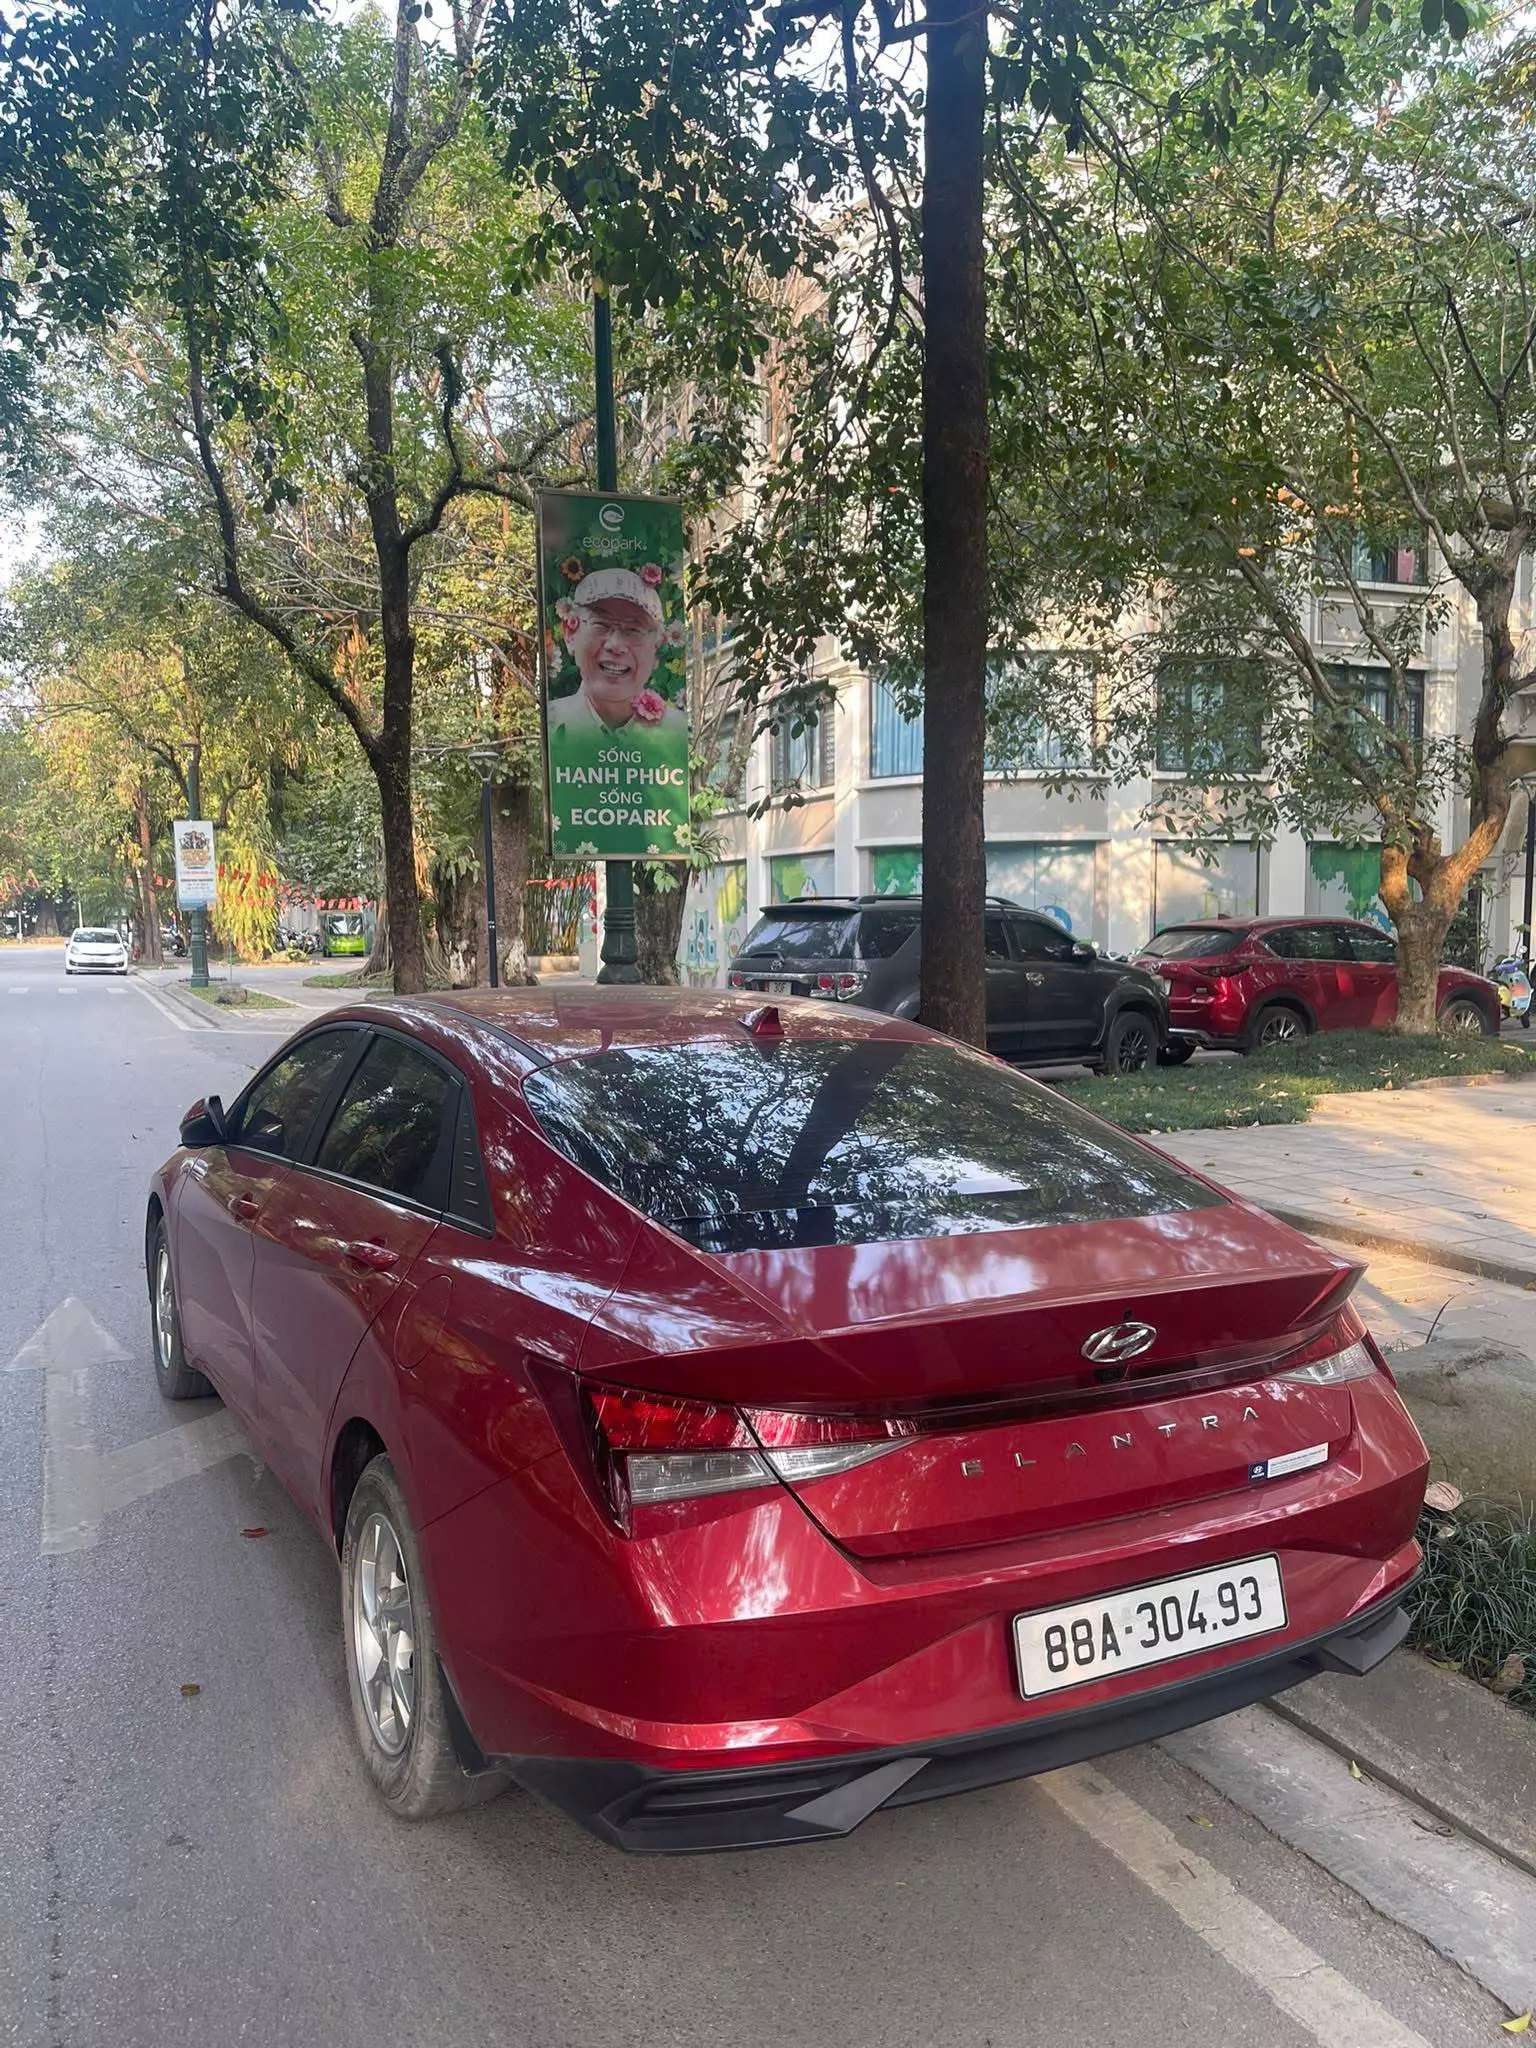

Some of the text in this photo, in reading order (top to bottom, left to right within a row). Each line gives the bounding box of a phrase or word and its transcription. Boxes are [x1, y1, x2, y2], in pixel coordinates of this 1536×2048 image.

[583, 536, 643, 551] ecopark
[598, 746, 642, 763] SỐNG
[556, 764, 685, 788] HẠNH PHÚC
[599, 787, 643, 804] SỐNG
[571, 808, 672, 826] ECOPARK
[960, 1406, 1259, 1477] ELANTRA
[1044, 1576, 1262, 1673] 88A-304.93
